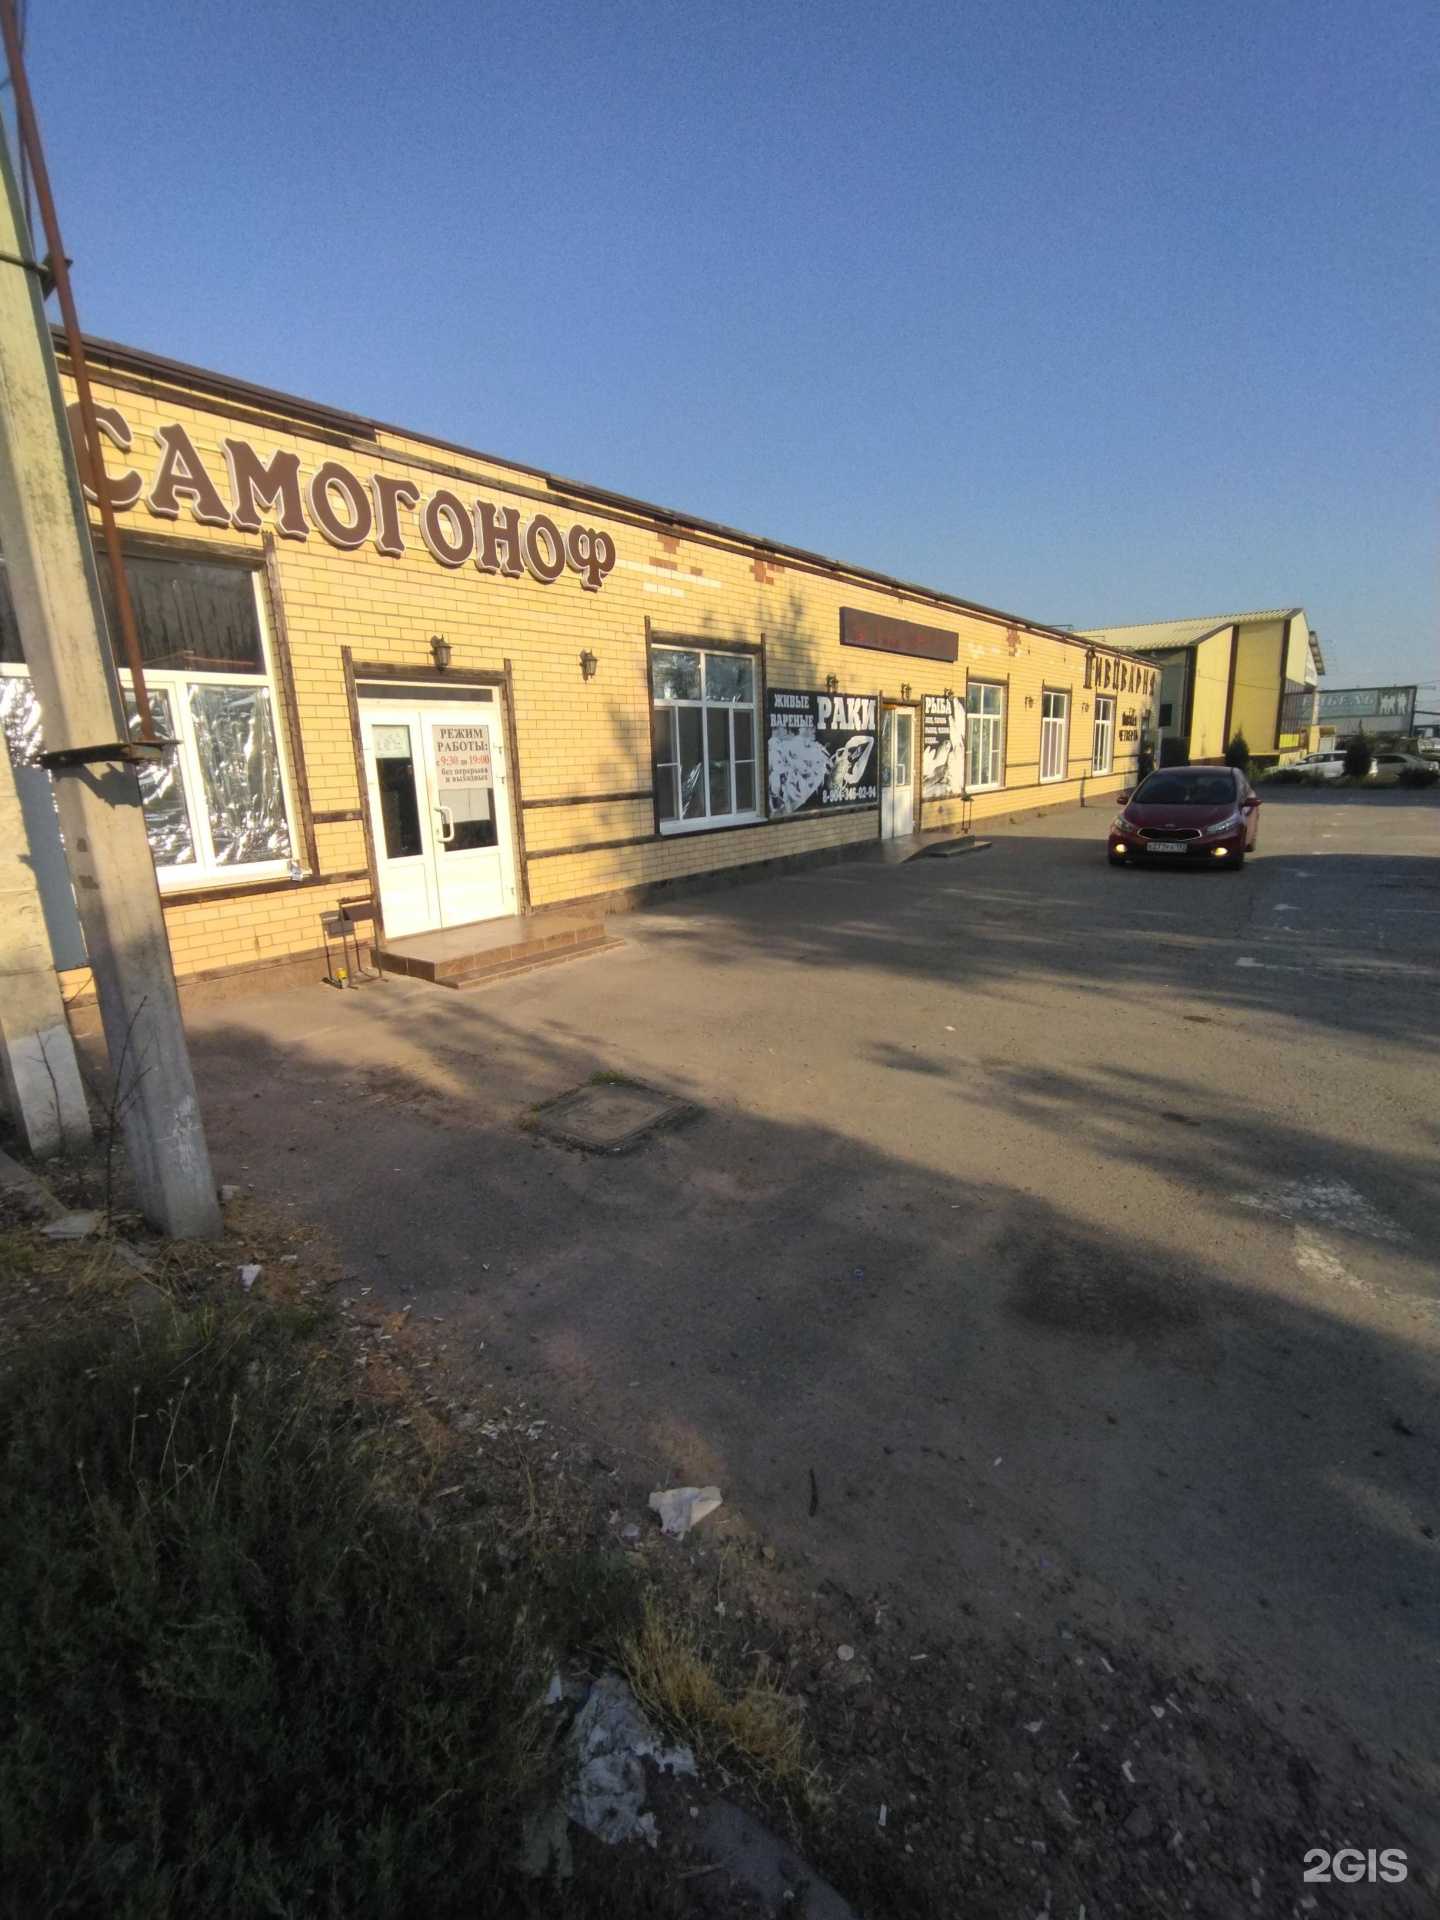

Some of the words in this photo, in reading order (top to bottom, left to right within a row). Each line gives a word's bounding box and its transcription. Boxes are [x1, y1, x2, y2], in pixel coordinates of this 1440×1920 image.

[66, 399, 617, 592] САМОГОНОФ
[774, 693, 810, 709] ЖИВЫЕ
[925, 696, 952, 715] РЫБА
[770, 713, 814, 728] ВАРЕНЫЕ
[817, 695, 876, 731] РАКИ
[440, 728, 483, 739] РЕЖИМ
[437, 741, 489, 752] РАБОТЫ:
